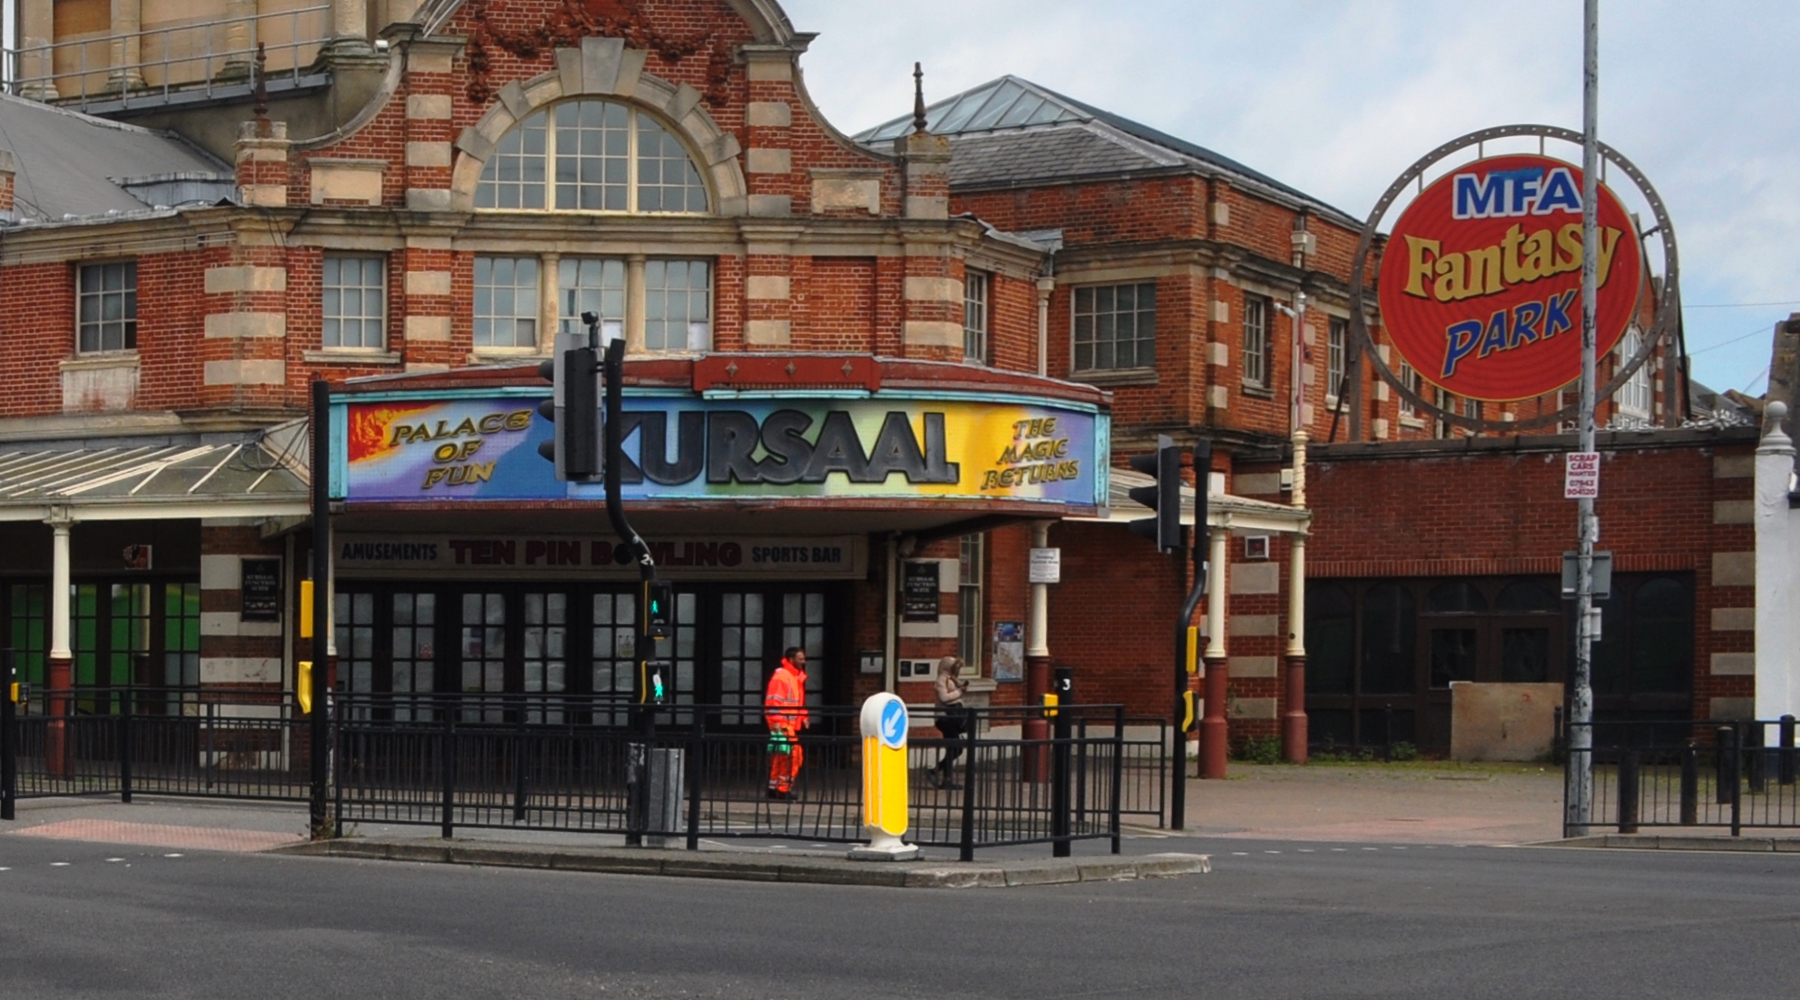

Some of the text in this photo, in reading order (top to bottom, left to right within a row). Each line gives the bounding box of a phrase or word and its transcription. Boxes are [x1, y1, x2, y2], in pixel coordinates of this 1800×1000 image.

[1454, 168, 1583, 219] MFA
[1402, 223, 1622, 301] Fantasy
[1440, 288, 1578, 379] PARK
[389, 409, 533, 446] PALACE
[1012, 418, 1057, 440] THE
[432, 439, 484, 463] OF
[996, 439, 1068, 465] MAGIC
[421, 461, 496, 490] FUN
[980, 461, 1078, 490] RETURNS
[341, 543, 437, 560] AMUSEMENTS
[450, 540, 515, 564] TEN
[525, 541, 581, 565] PIN
[752, 546, 808, 563] SPORTS
[812, 546, 841, 563] BAR
[1062, 678, 1071, 691] 3
